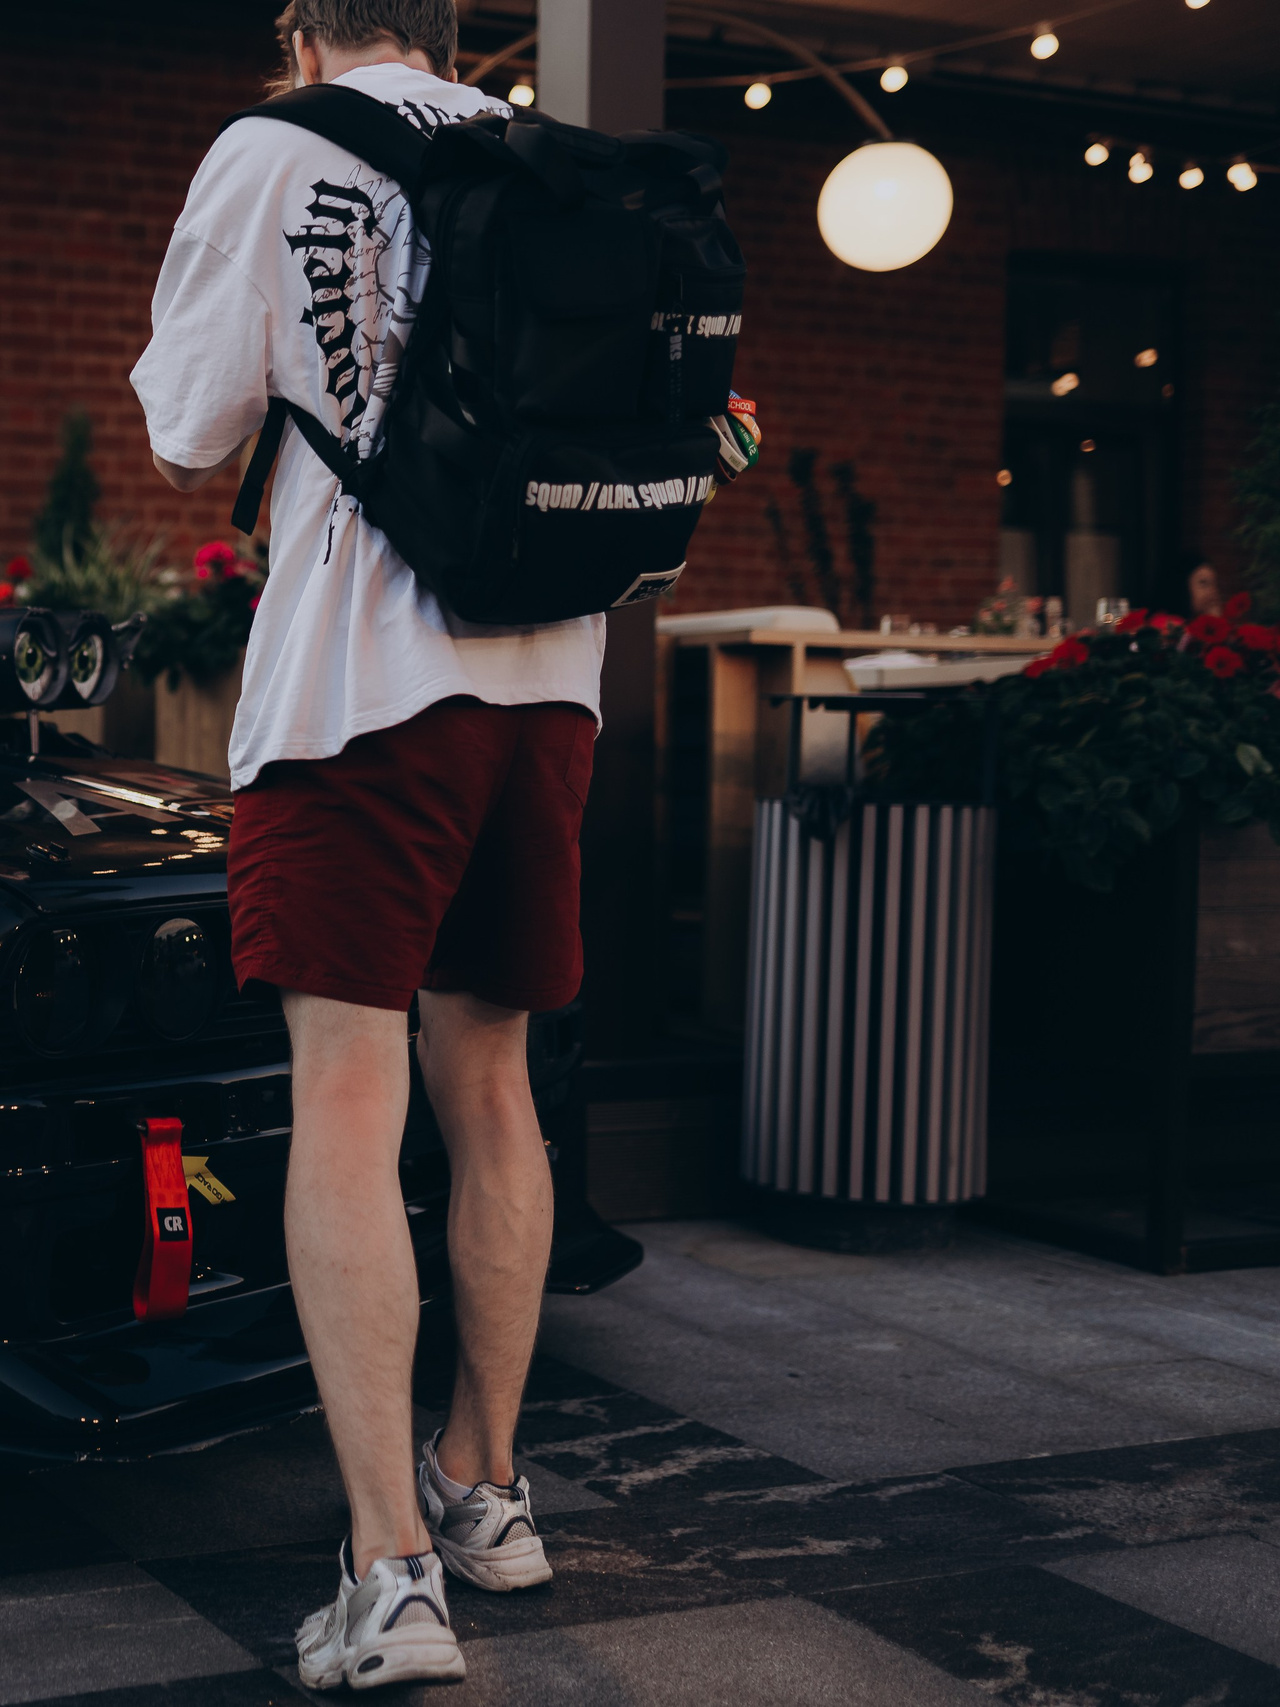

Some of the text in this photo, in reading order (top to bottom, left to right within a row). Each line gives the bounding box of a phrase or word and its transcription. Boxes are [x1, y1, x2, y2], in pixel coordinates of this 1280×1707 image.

[282, 178, 378, 452] ociety
[524, 480, 584, 512] SQUAD
[597, 484, 640, 510] BLACK
[638, 477, 686, 510] SQUAD
[163, 1215, 184, 1232] CR
